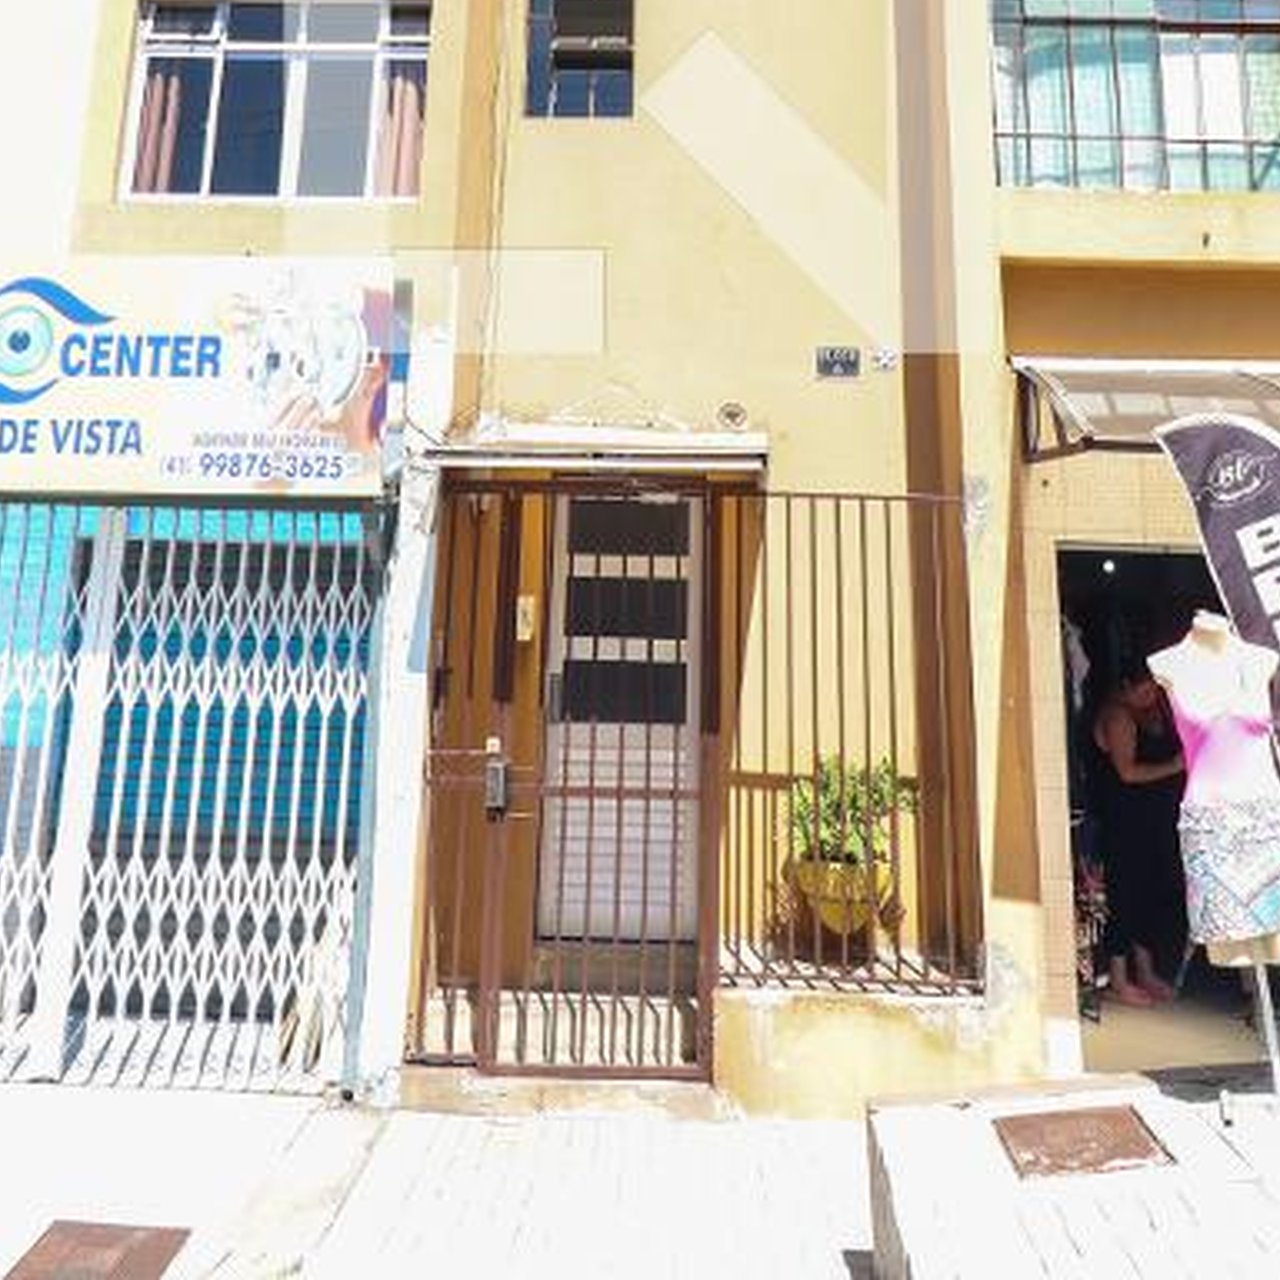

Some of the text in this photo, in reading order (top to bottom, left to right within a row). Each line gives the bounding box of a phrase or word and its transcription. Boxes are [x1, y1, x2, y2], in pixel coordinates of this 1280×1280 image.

[59, 333, 222, 379] CENTER
[49, 419, 144, 456] VISTA
[199, 452, 343, 479] 99876-3625
